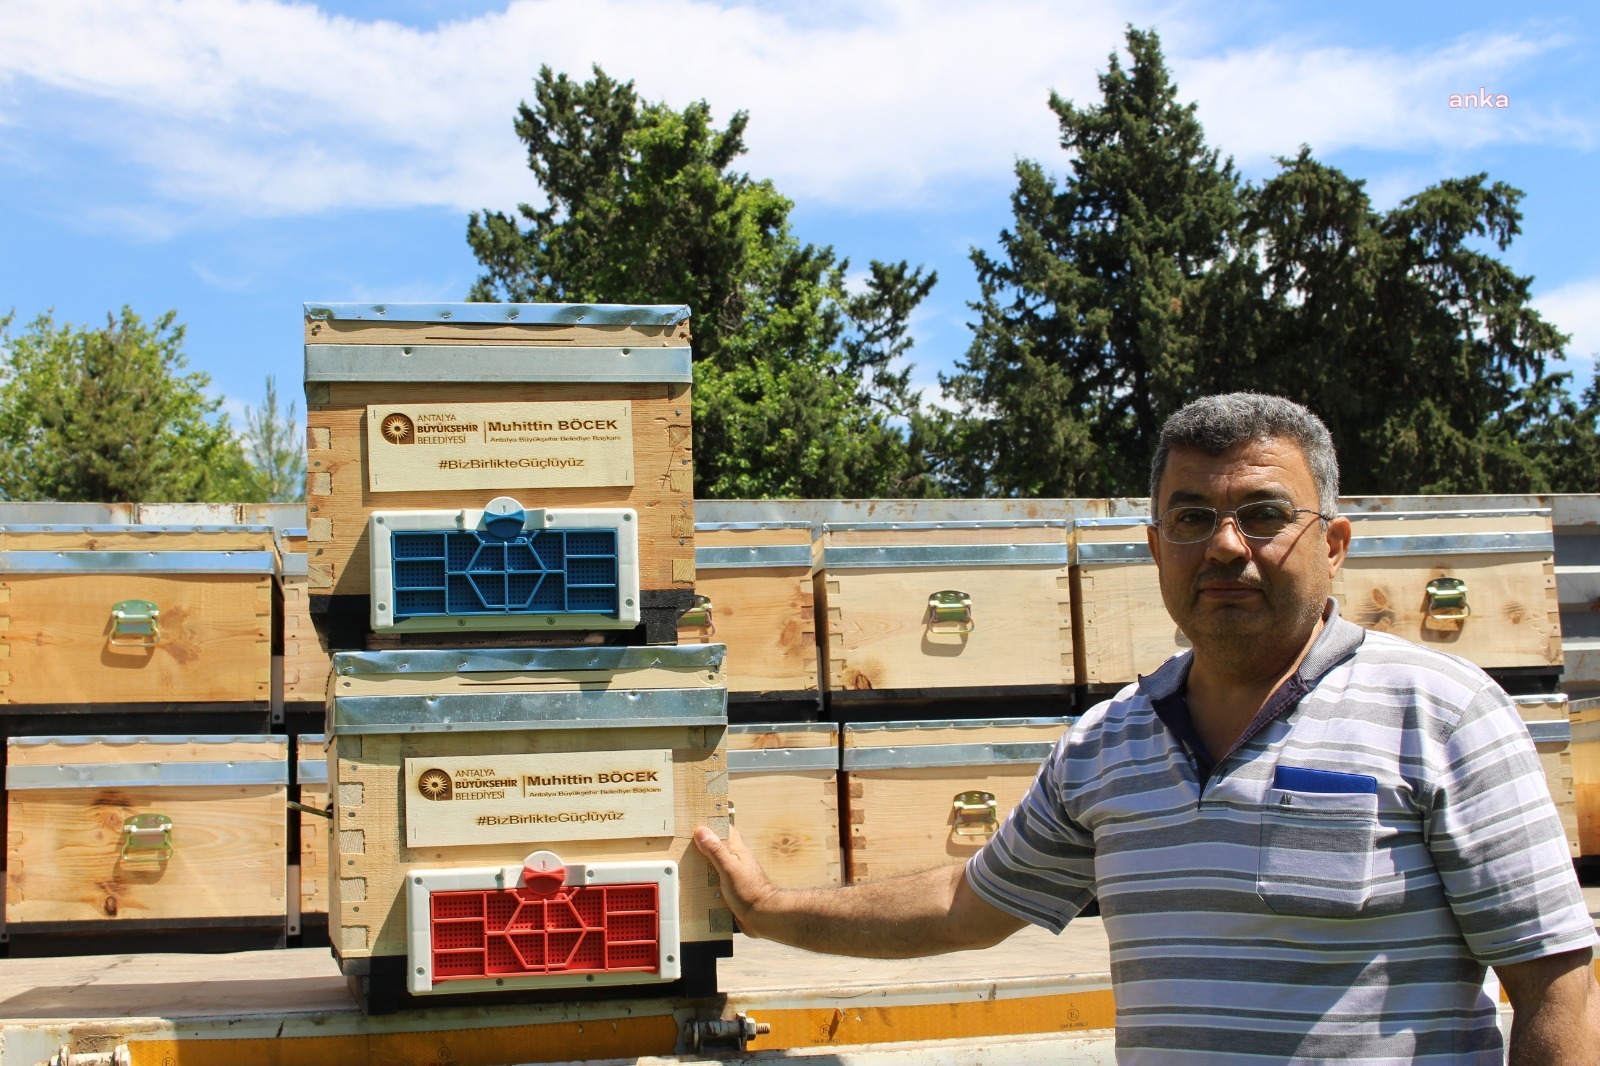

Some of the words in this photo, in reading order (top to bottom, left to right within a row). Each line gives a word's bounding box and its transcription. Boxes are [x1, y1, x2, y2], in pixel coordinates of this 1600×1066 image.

[417, 414, 457, 422] ANTALYA
[488, 420, 553, 432] Muhittin
[558, 418, 618, 431] BÖCEK
[438, 457, 585, 470] #BizBirlikteGüçlüyüz
[455, 769, 496, 777] ANTALYA
[527, 775, 592, 786] Muhittin
[598, 771, 658, 783] BÖCEK
[477, 811, 625, 826] #BizBirlikteGüçlüyüz
